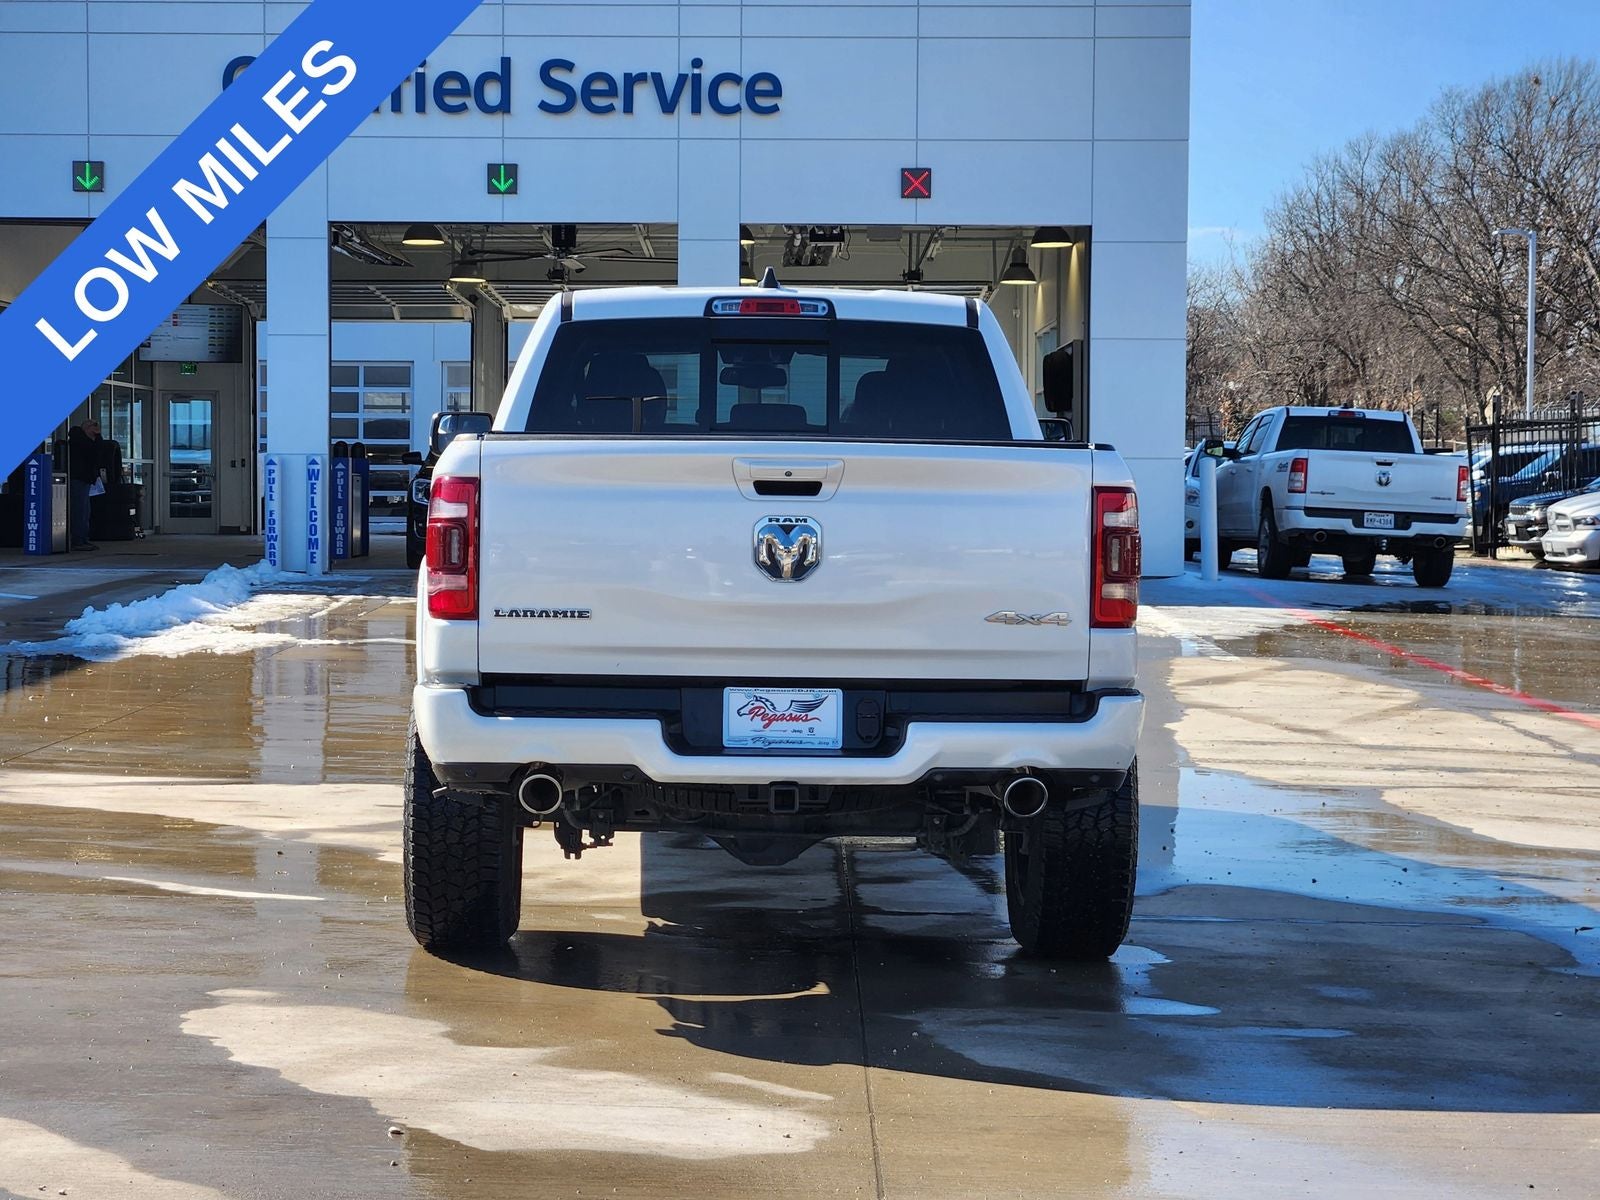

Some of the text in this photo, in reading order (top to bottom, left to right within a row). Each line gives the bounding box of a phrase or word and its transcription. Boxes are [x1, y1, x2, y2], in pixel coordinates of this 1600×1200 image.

[537, 57, 783, 115] Service
[27, 502, 38, 551] FORWARD
[266, 469, 278, 567] PULL FORWARD
[307, 468, 320, 564] WELCOME
[334, 505, 346, 555] FORWARD
[493, 608, 591, 619] LARAMIE
[748, 705, 821, 729] Pegasus
